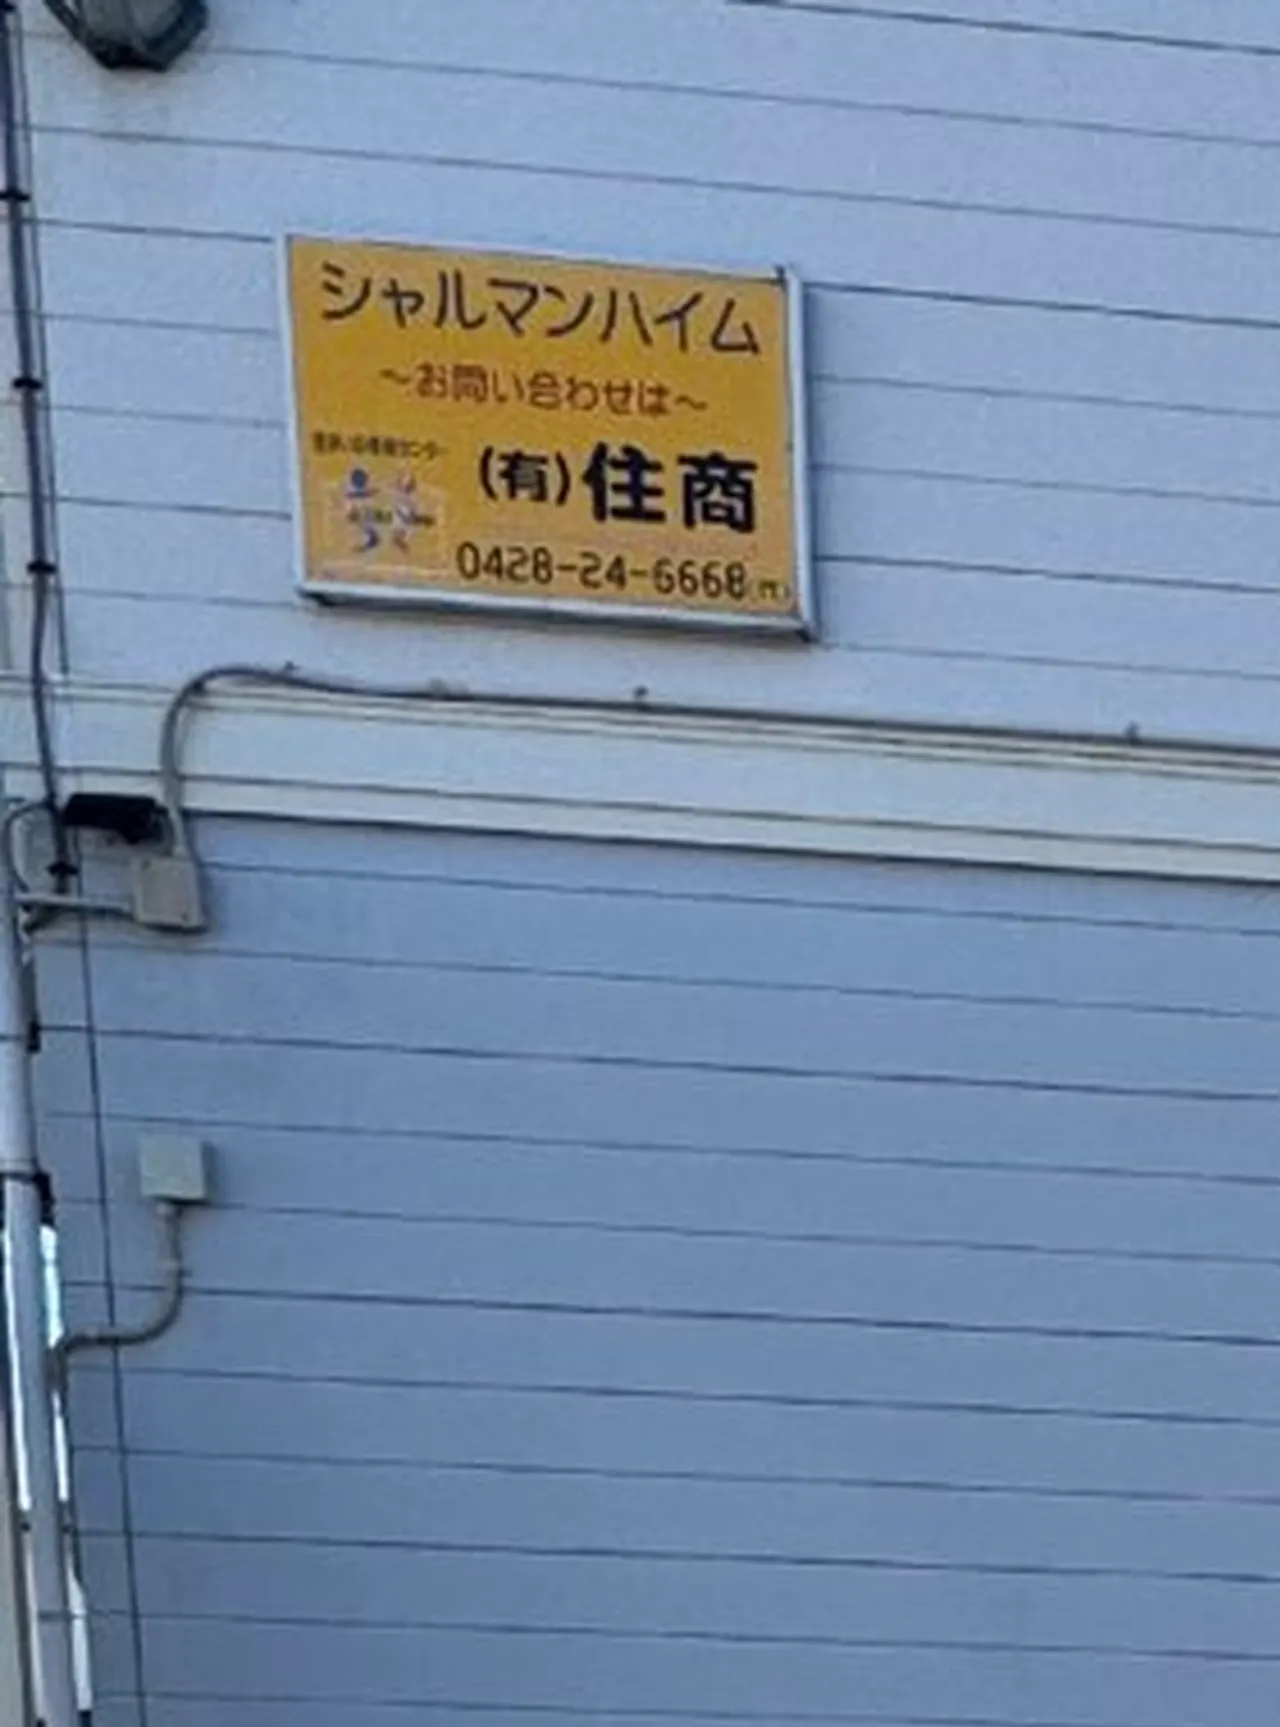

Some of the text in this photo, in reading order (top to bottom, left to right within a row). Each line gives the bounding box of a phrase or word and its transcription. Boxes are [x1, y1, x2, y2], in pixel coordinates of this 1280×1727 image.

[319, 262, 760, 355] シャルマンハイム
[456, 541, 747, 600] 0428-24-6668
